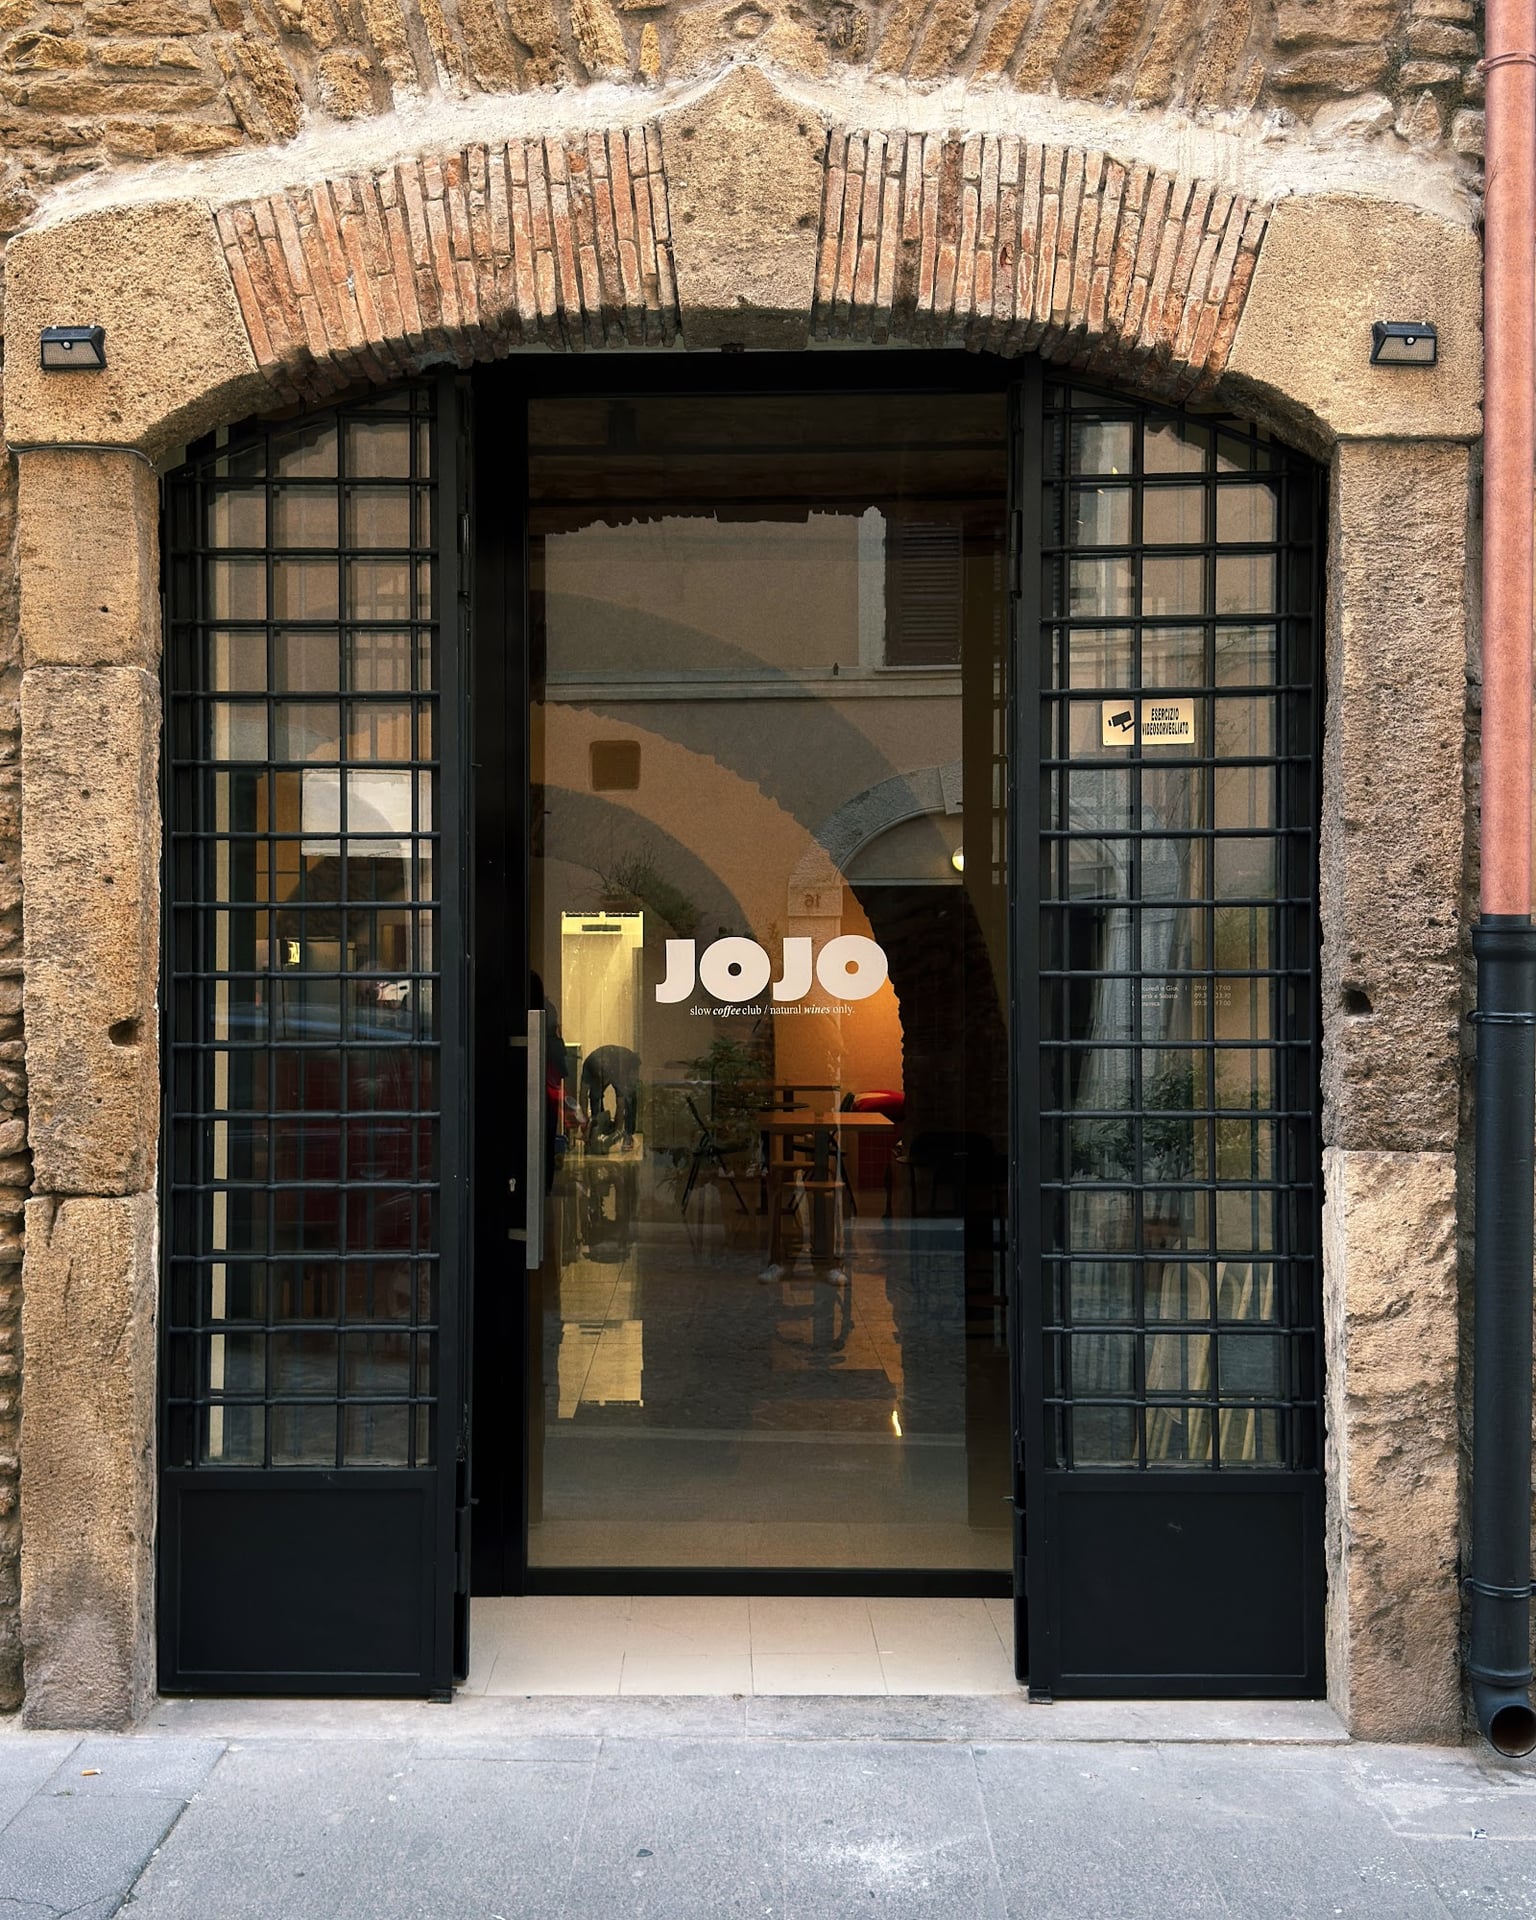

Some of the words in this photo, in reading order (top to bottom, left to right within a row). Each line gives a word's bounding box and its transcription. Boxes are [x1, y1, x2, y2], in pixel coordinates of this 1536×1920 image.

[1151, 707, 1180, 721] ESERCIZIO
[1142, 722, 1189, 736] VIDEOSORVEGLIATO
[655, 935, 889, 1004] JOJO
[690, 1005, 712, 1016] slow
[712, 1004, 742, 1017] coffee
[742, 1005, 762, 1015] club
[763, 1004, 768, 1016] /
[769, 1005, 802, 1015] natural
[803, 1005, 830, 1015] wines
[832, 1004, 855, 1016] only.
